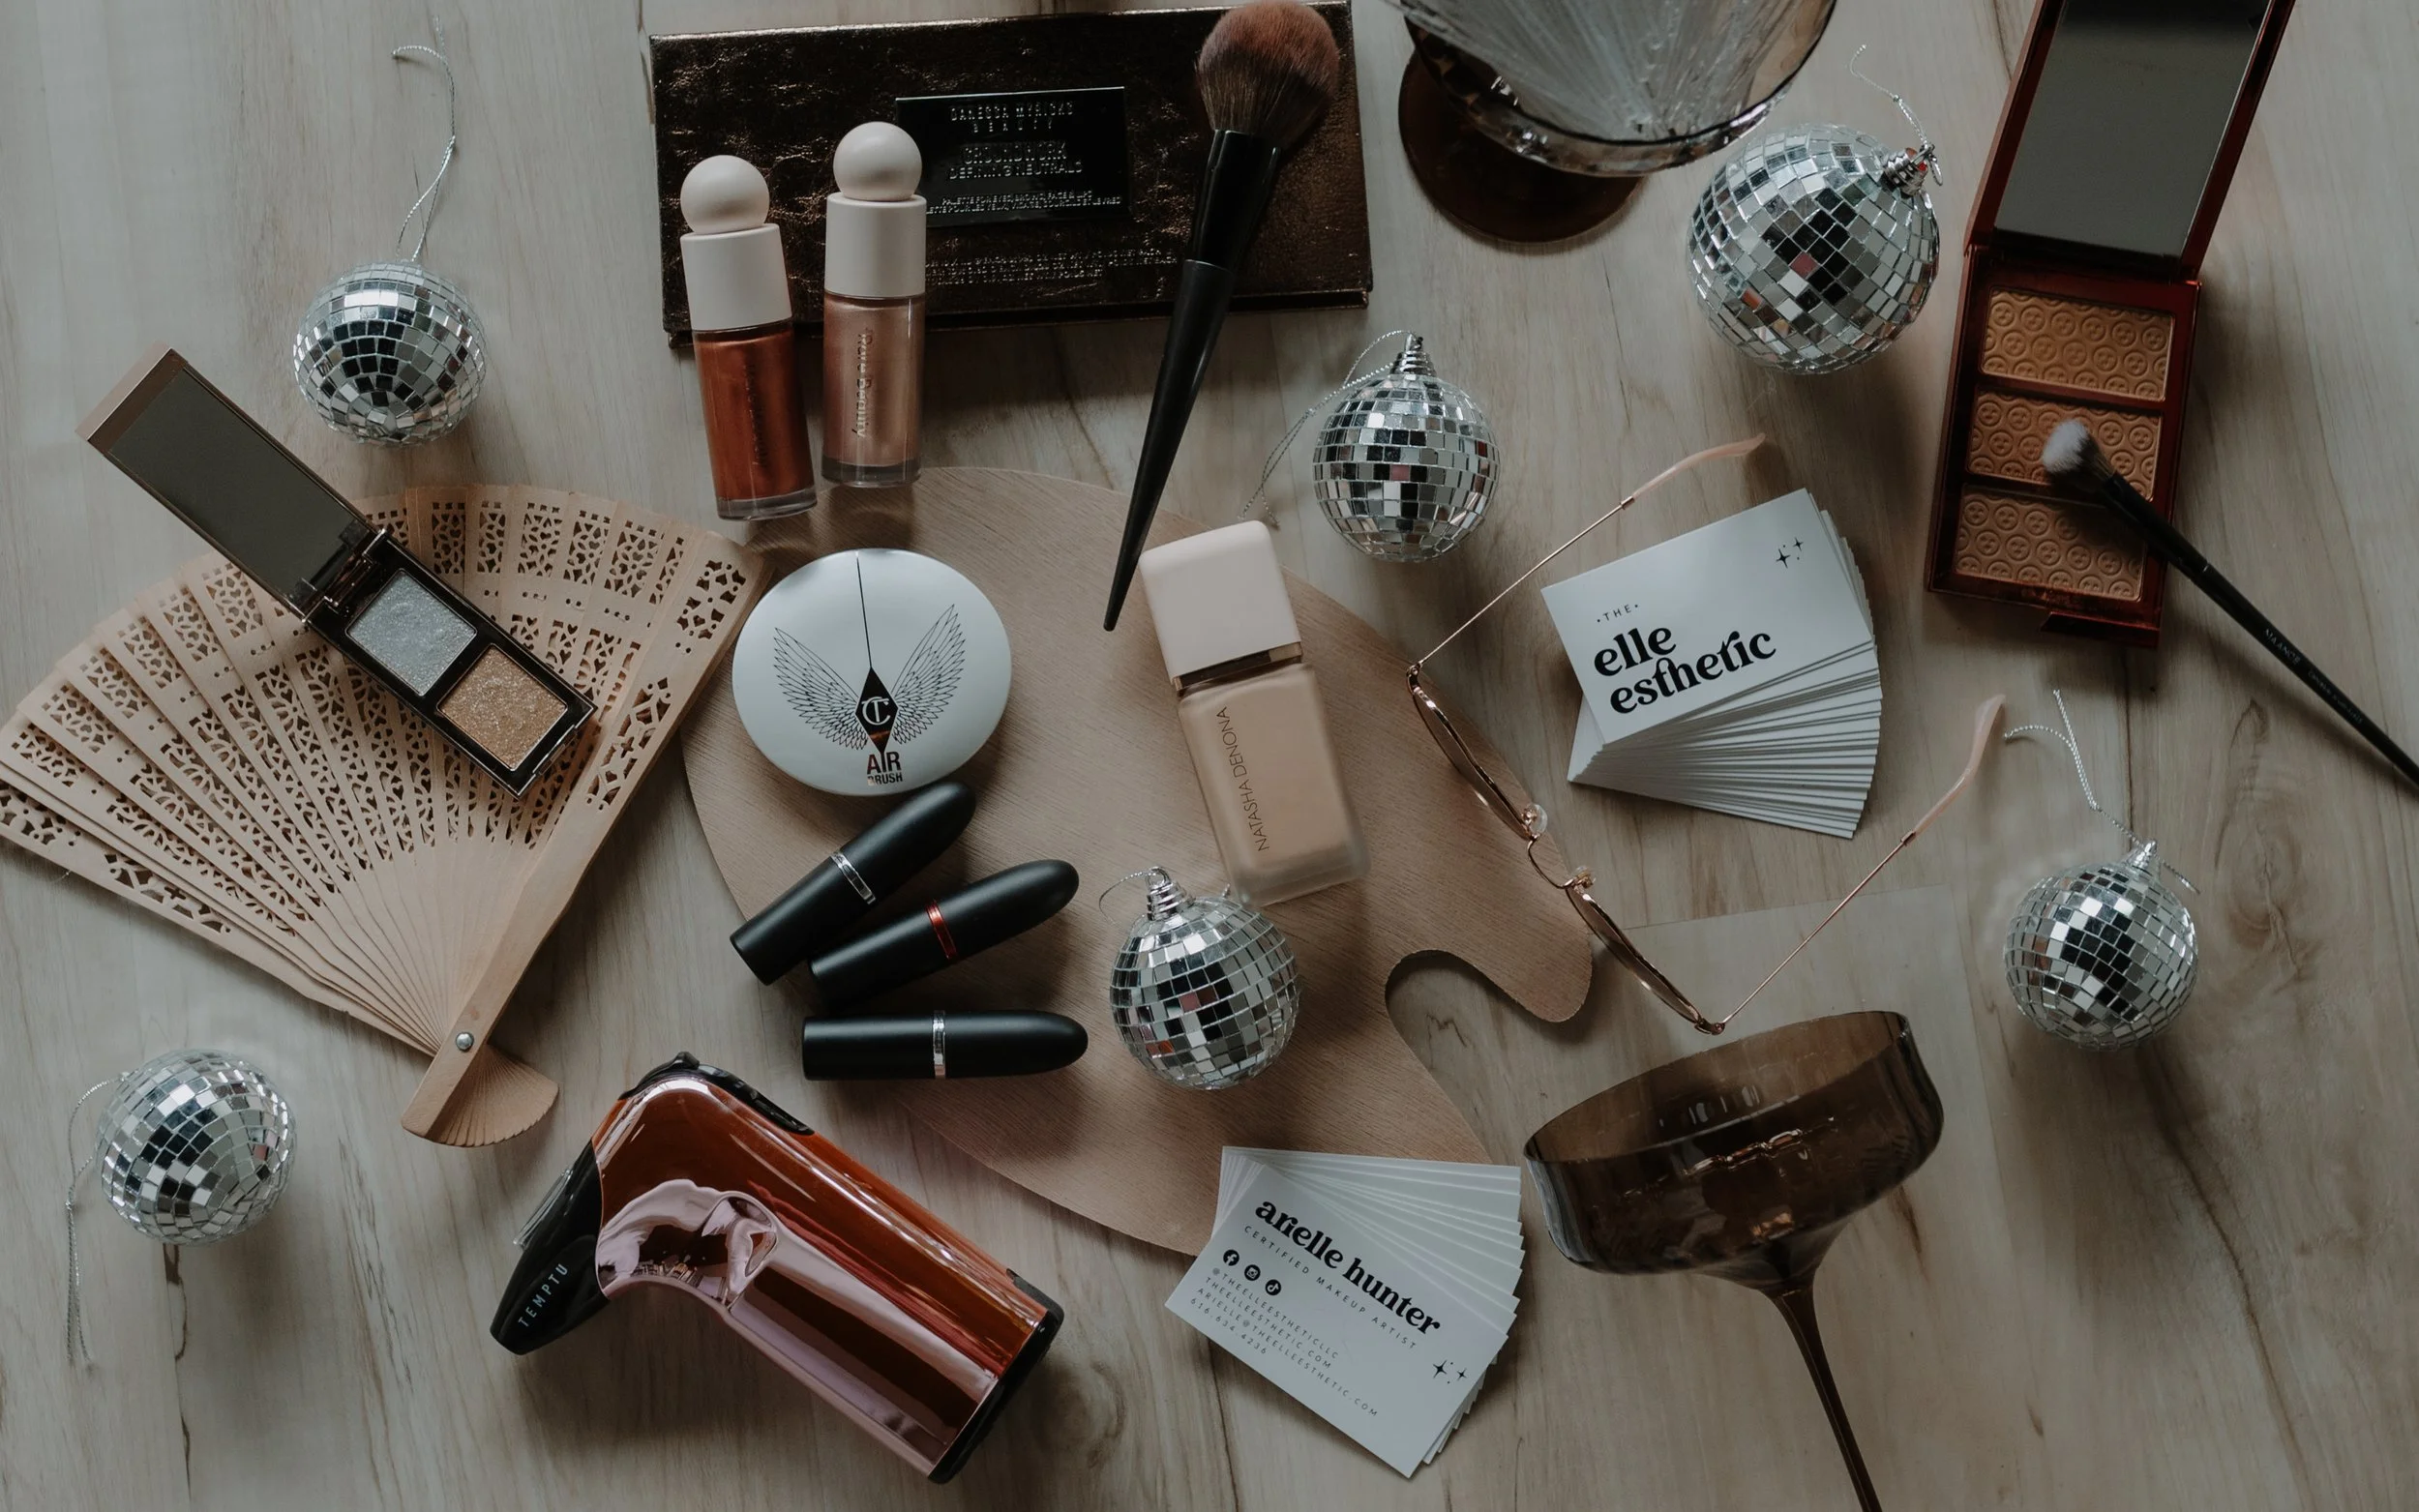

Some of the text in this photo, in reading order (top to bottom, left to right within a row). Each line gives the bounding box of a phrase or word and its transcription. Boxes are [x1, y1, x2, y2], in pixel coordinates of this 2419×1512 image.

[1602, 604, 1632, 622] THE
[1594, 627, 1677, 676] elle
[1610, 631, 1777, 714] esthetic
[866, 751, 902, 775] AIR
[1216, 706, 1270, 851] NATASHA DENONA
[518, 1263, 568, 1327] TEMPTU
[1243, 1225, 1418, 1349] CERTIFIED MAKEUP ARTIST
[1255, 1201, 1441, 1335] arielle hunter
